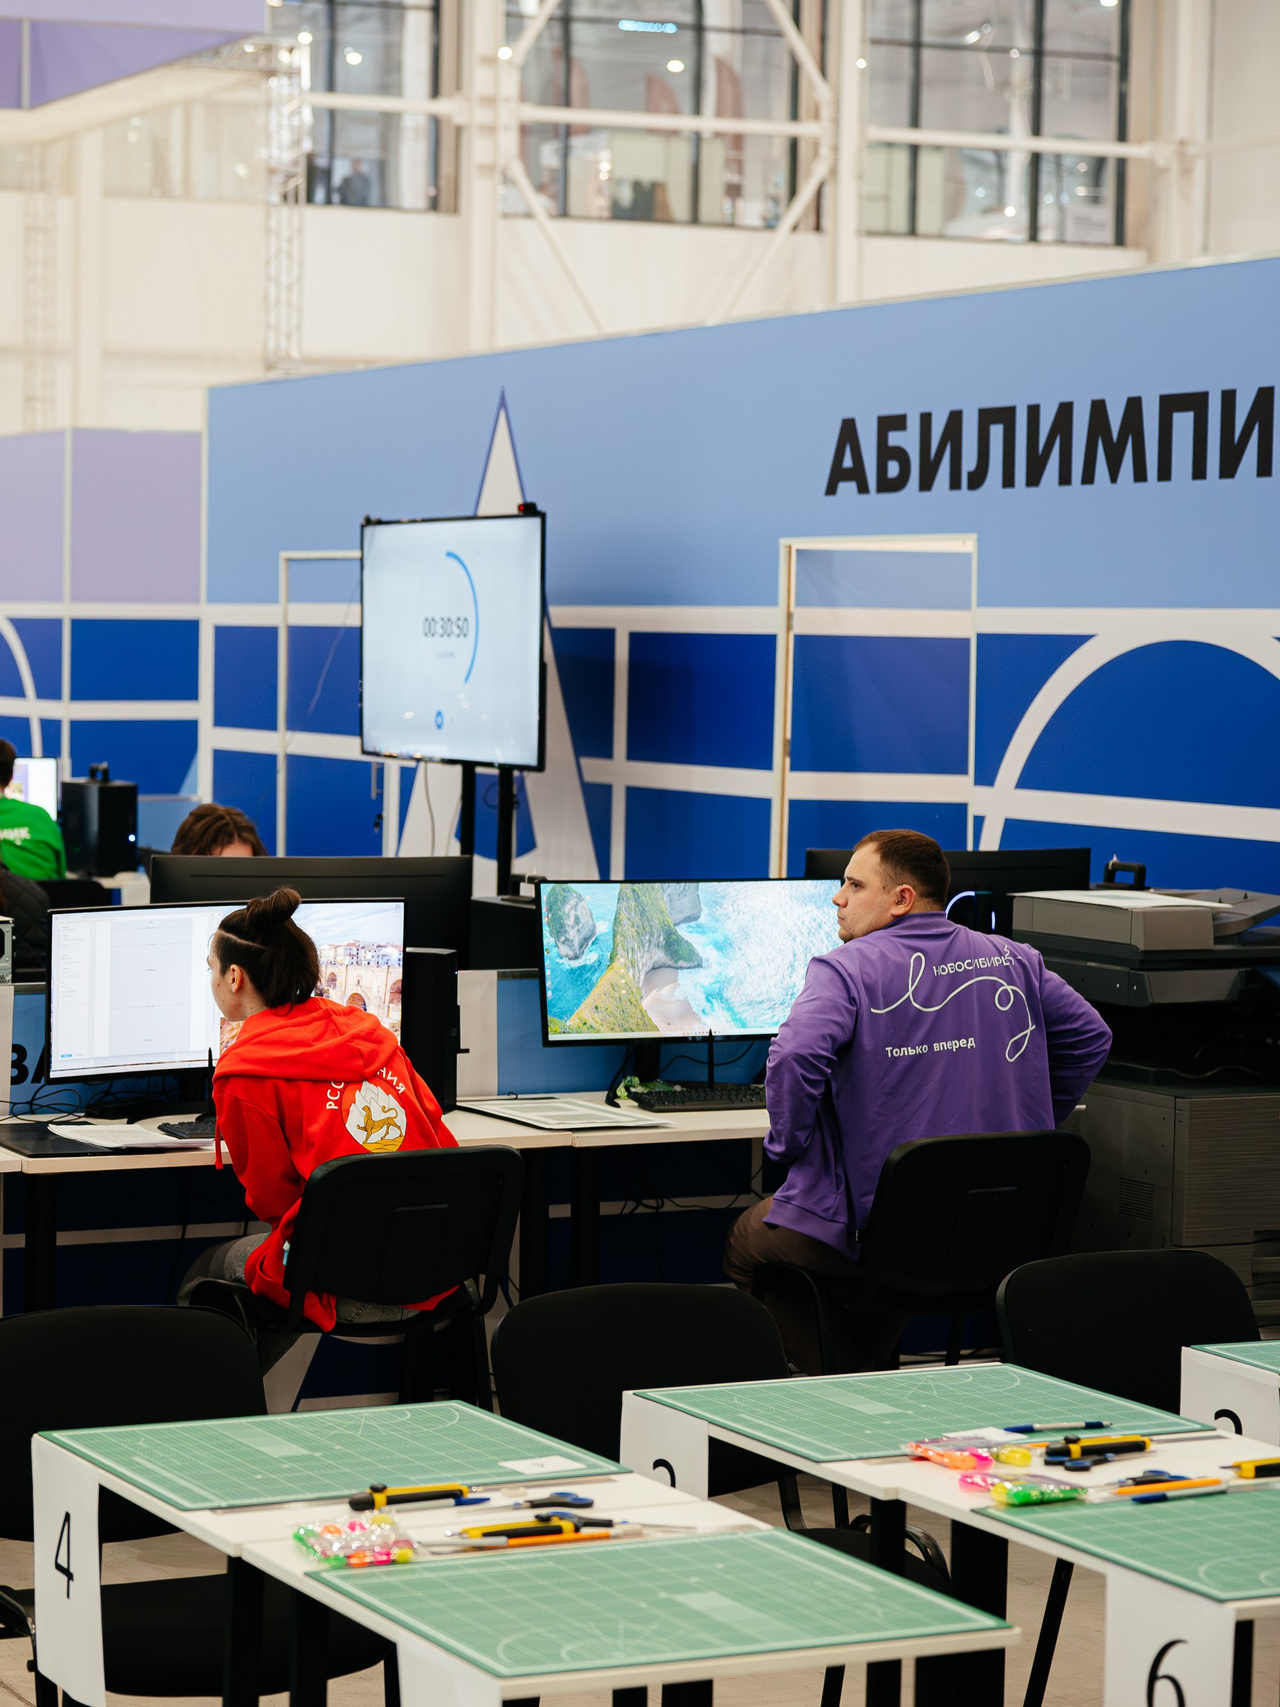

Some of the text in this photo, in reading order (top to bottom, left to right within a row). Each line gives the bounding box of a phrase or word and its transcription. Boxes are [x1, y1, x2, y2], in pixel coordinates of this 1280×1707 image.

[824, 386, 1276, 497] АБИЛИМПИ
[422, 616, 469, 638] 00:30:50
[885, 1037, 976, 1058] Только вперед
[54, 1510, 74, 1600] 4
